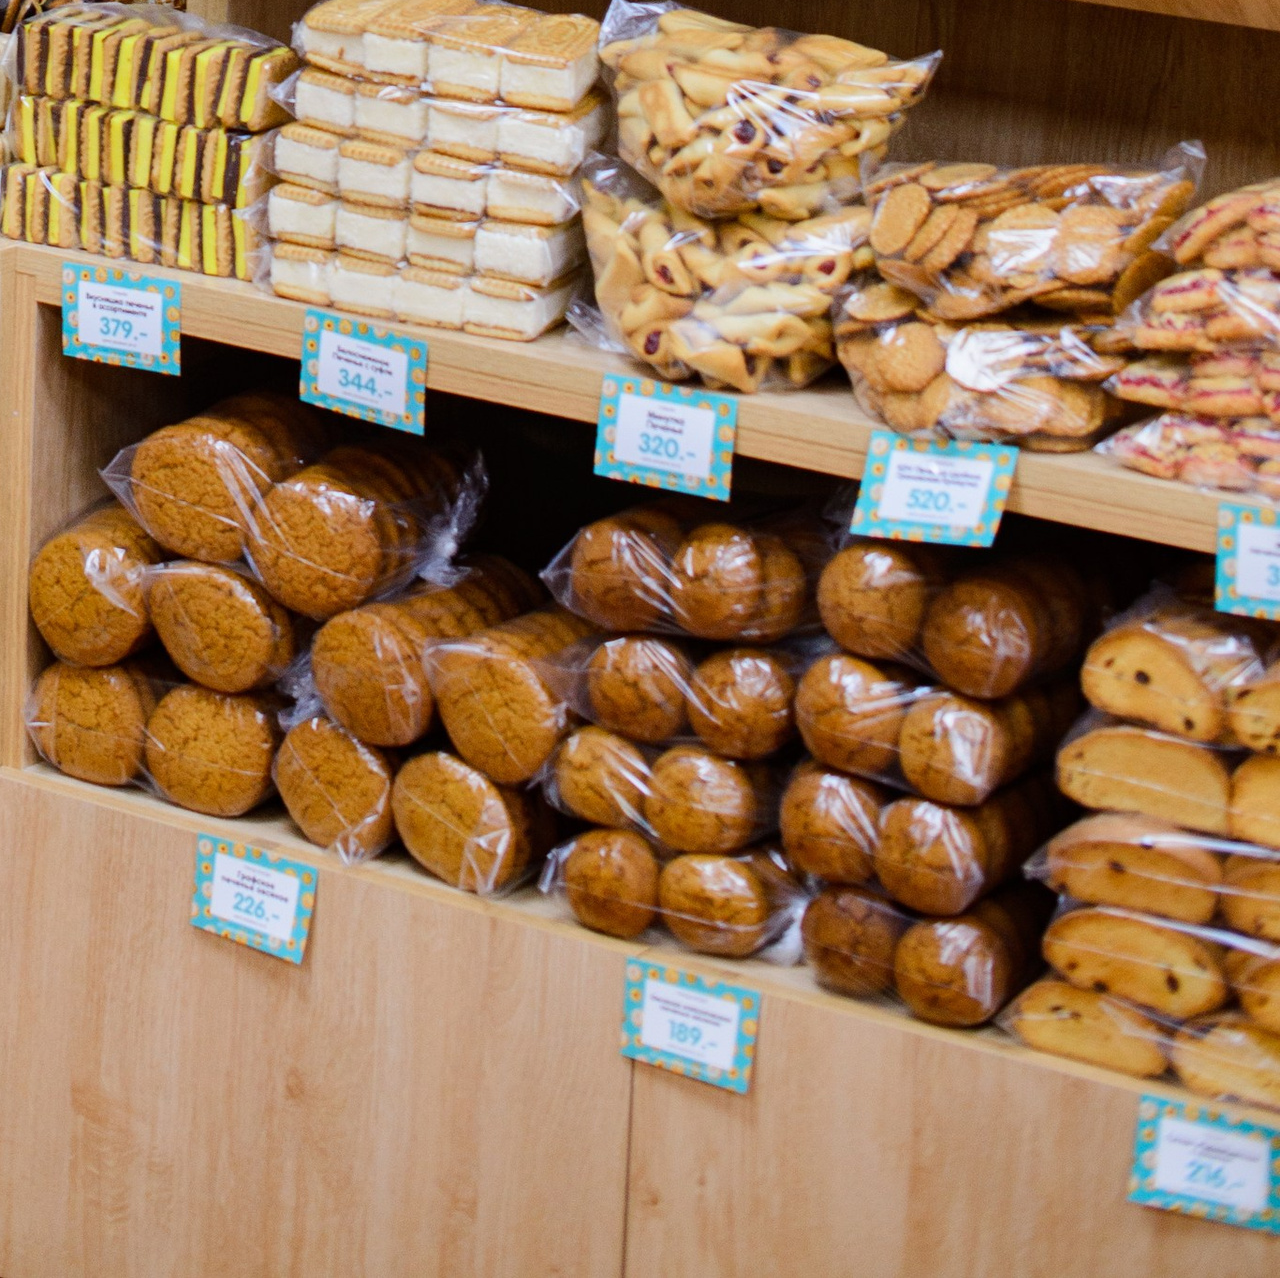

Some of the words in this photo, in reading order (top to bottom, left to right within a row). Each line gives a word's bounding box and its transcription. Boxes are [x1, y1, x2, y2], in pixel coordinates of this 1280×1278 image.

[99, 317, 148, 341] 379.-
[338, 368, 392, 398] 344.-
[639, 432, 695, 461] 320.-
[232, 893, 280, 922] 226.-
